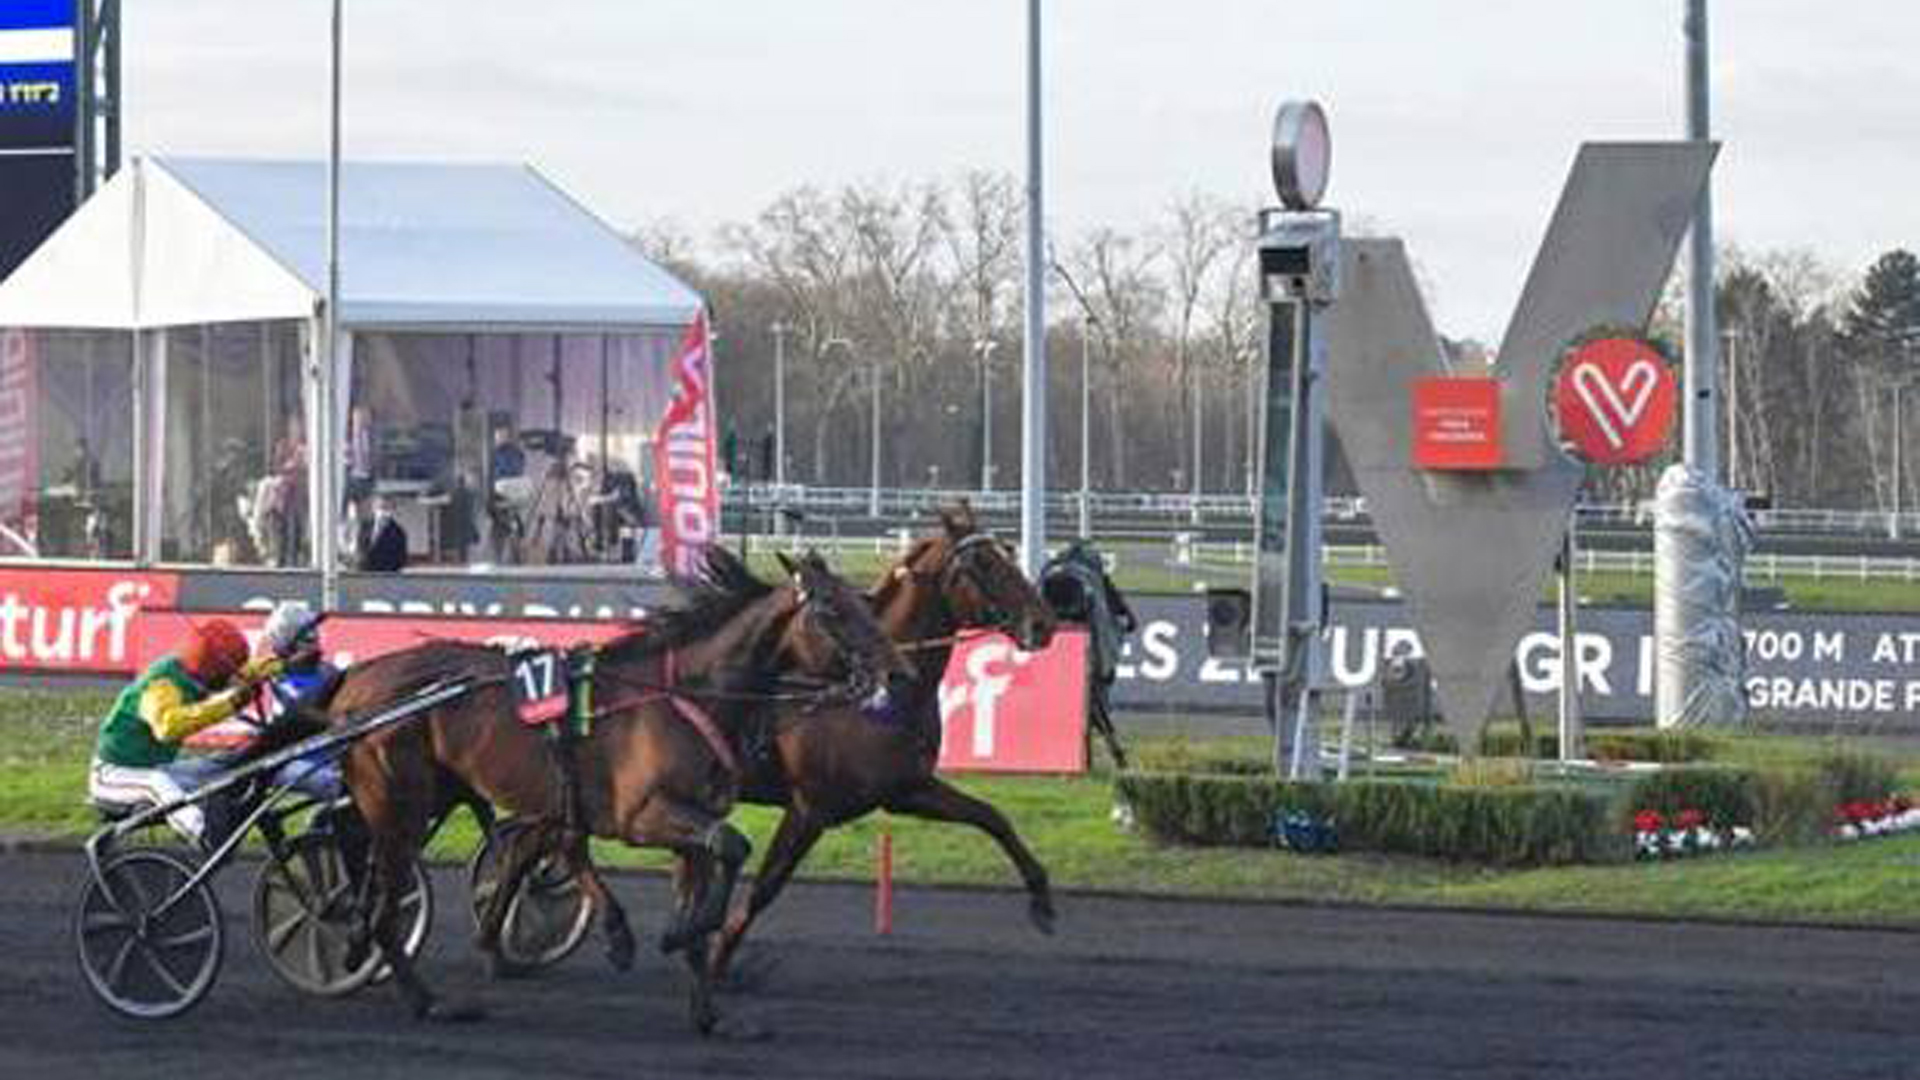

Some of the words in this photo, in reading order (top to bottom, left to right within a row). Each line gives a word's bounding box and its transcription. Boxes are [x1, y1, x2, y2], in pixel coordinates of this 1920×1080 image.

[1813, 632, 1845, 662] M
[515, 653, 554, 701] 17
[1745, 676, 1896, 711] GRANDE
